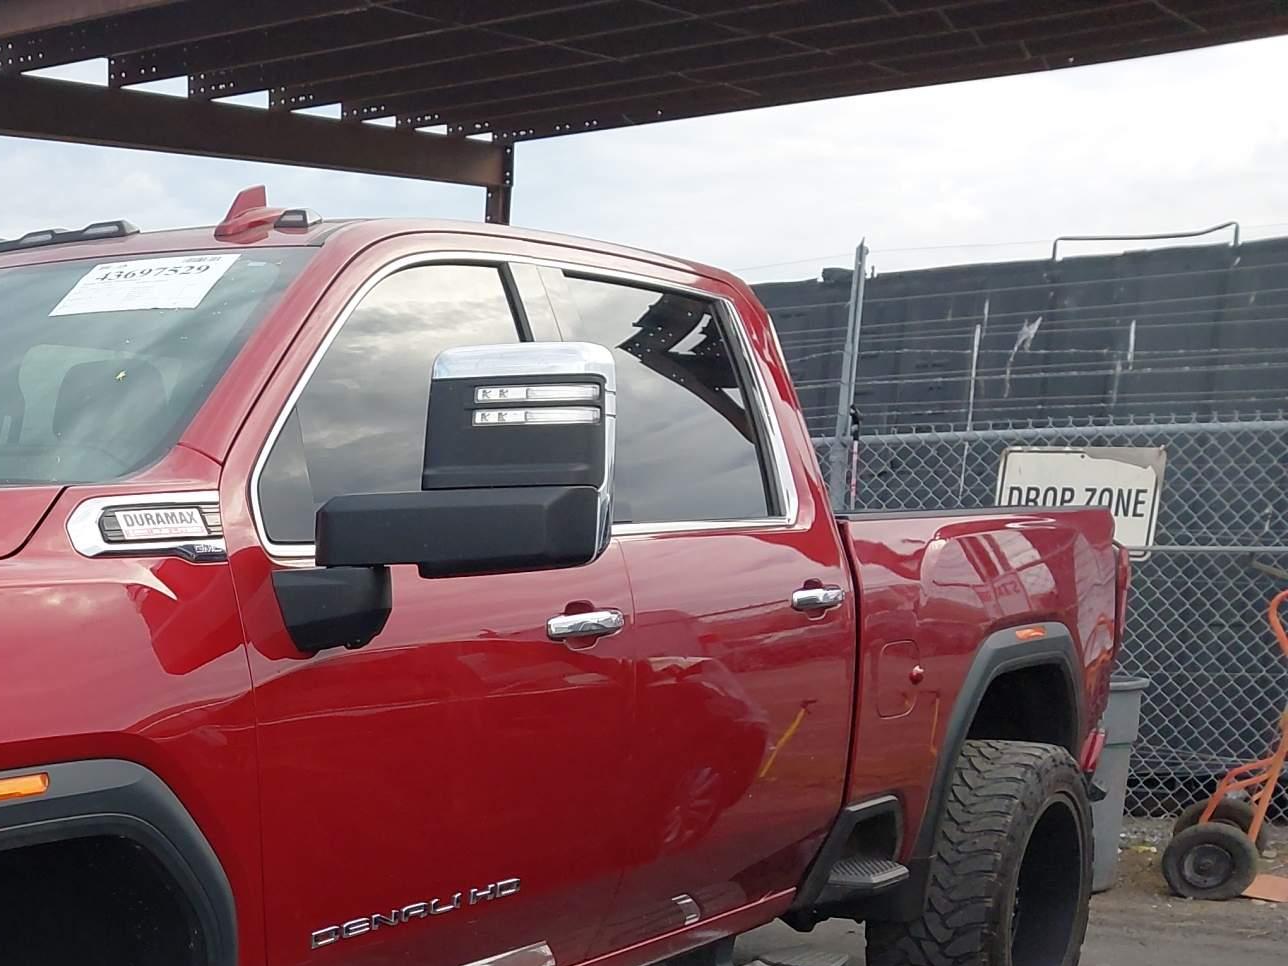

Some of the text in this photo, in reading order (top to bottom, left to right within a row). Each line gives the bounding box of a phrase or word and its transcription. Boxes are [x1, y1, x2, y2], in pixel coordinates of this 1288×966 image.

[95, 264, 211, 282] 43697529
[1007, 486, 1148, 518] DROP ZONE
[122, 510, 198, 528] DURAMAX
[311, 878, 521, 950] DENALI HD
